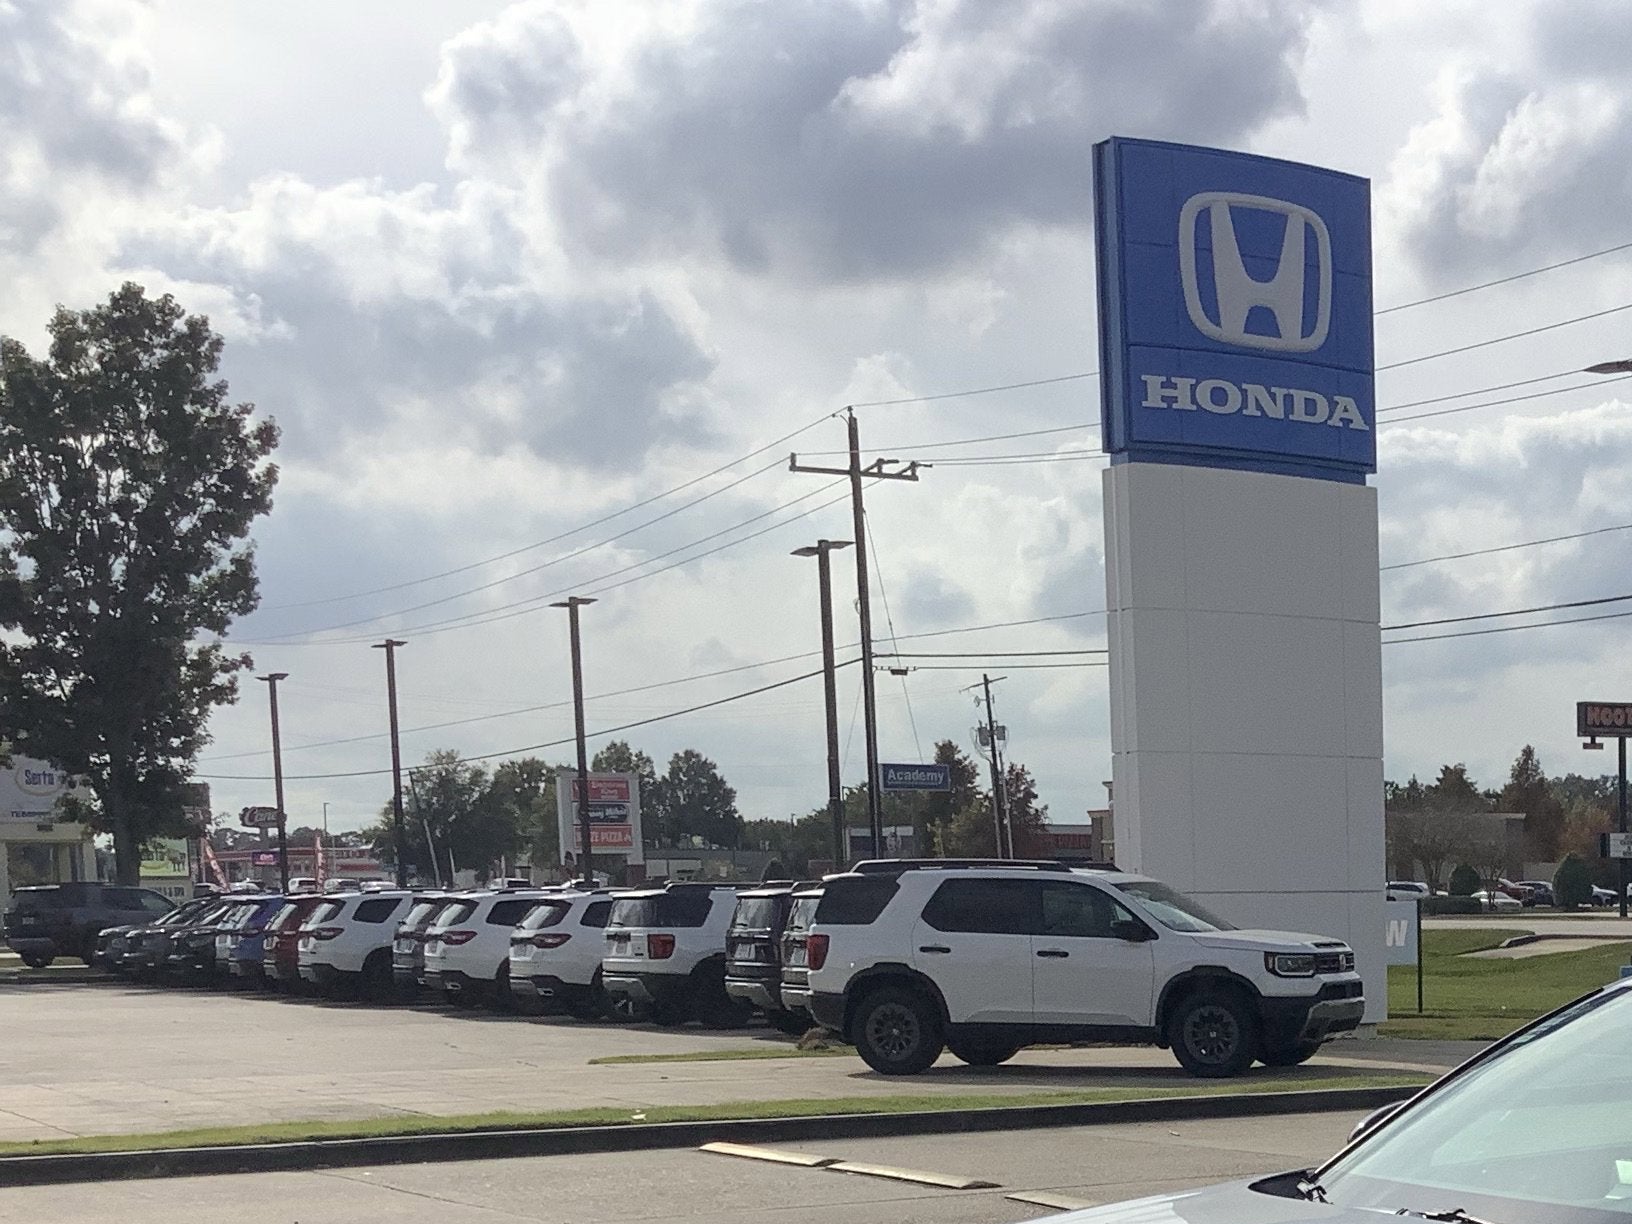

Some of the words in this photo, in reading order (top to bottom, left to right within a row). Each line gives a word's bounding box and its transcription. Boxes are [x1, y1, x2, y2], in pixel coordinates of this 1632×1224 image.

[1140, 374, 1370, 431] HONDA
[24, 769, 55, 785] Serta
[887, 768, 945, 785] Academy
